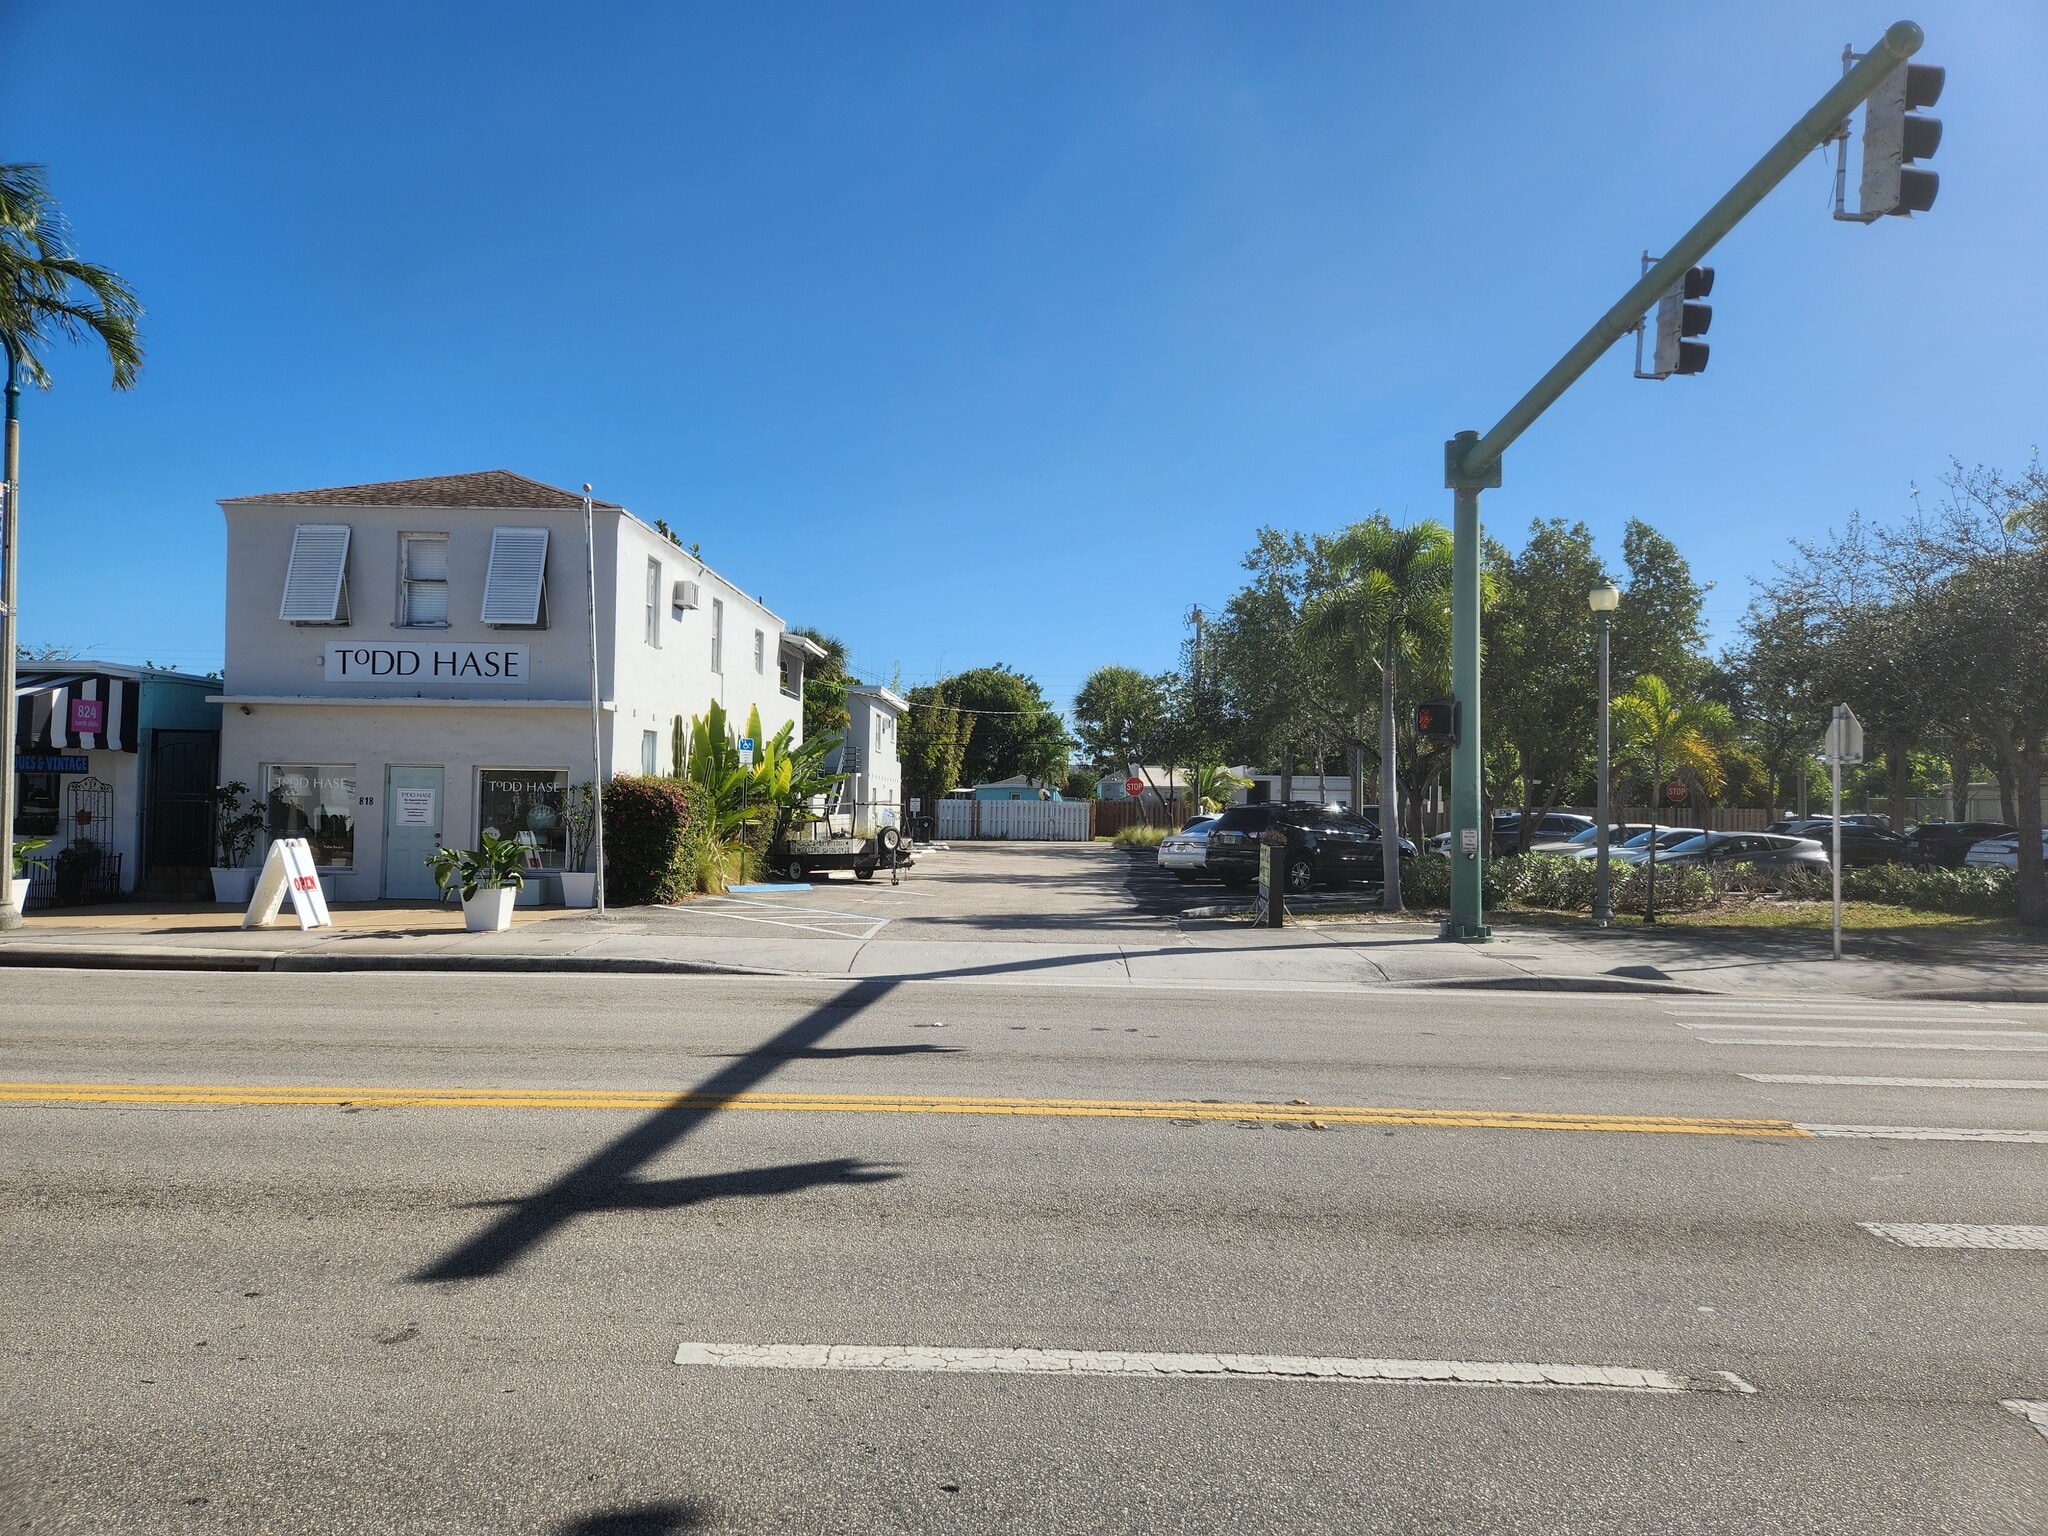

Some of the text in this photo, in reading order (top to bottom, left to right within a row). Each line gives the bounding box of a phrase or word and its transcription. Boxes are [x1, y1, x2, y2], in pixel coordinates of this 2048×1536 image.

[433, 651, 519, 677] HASE
[77, 704, 97, 719] 824
[47, 757, 87, 771] VINTAGE
[313, 778, 347, 789] HASE
[526, 781, 560, 793] HASE
[1126, 782, 1143, 791] STOP
[1668, 787, 1686, 796] STOP
[359, 796, 374, 805] 818
[294, 876, 317, 892] OPEN
